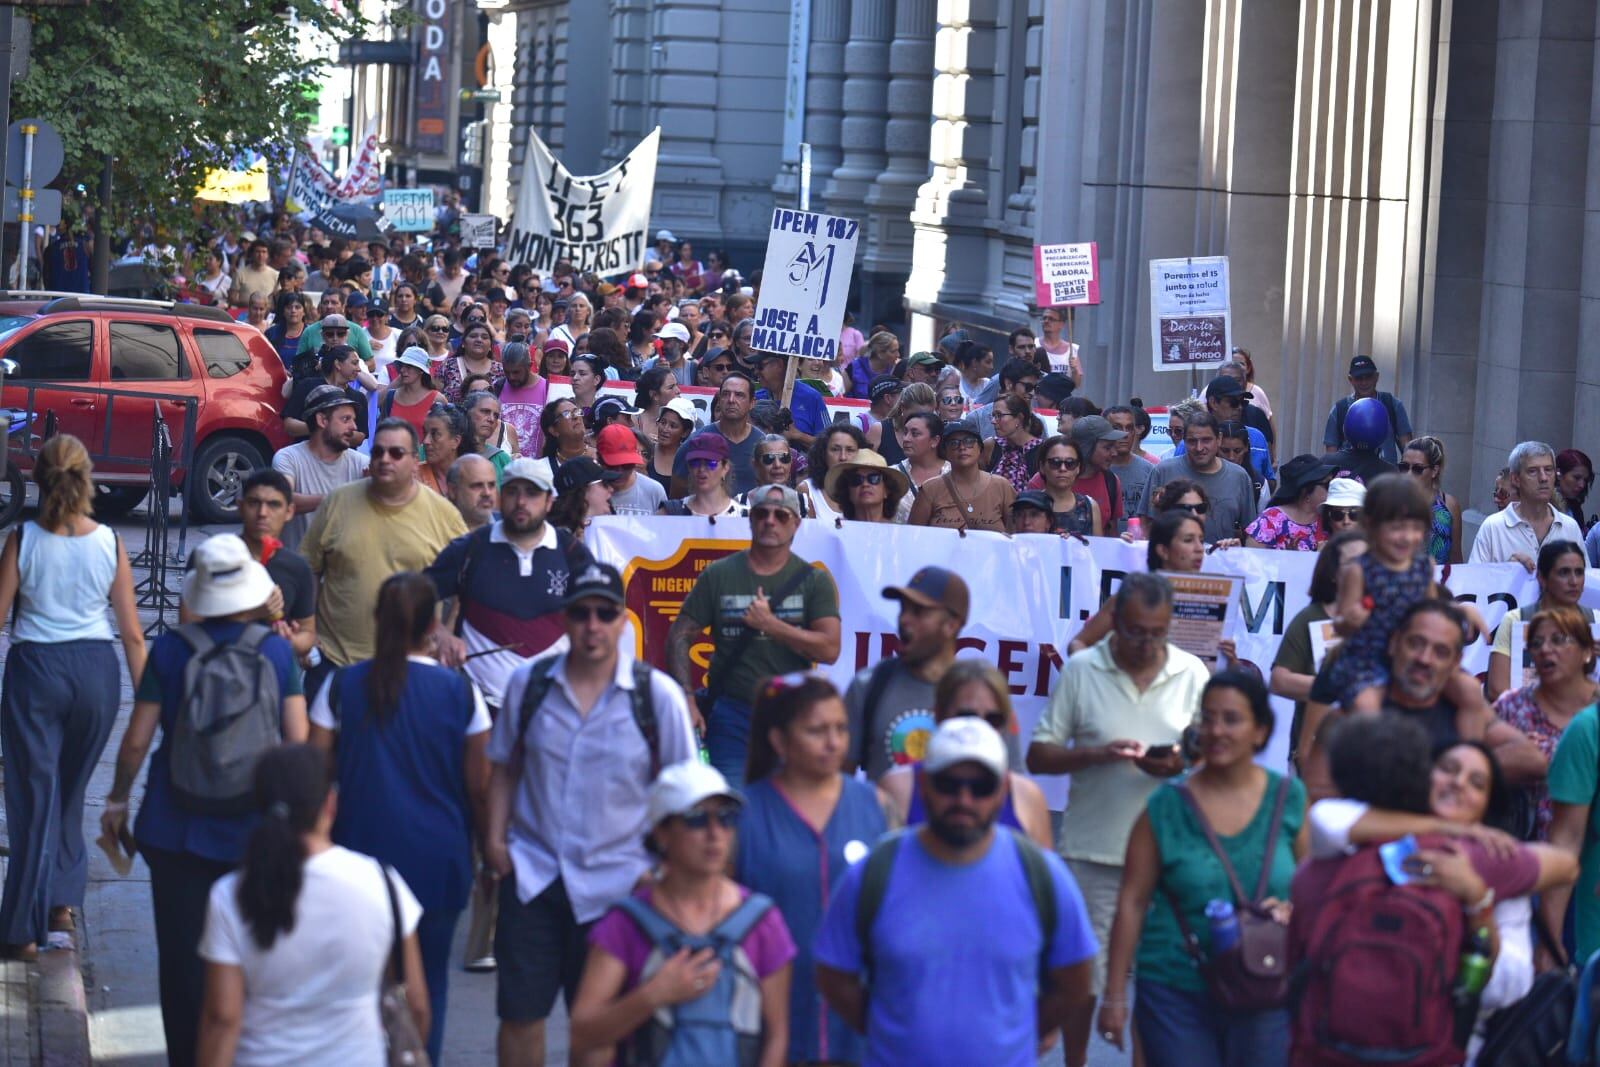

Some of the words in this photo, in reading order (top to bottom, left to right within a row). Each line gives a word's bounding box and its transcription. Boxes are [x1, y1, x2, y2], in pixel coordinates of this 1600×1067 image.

[394, 205, 426, 227] 101
[549, 194, 604, 243] 363
[773, 209, 820, 235] IPEM
[826, 217, 859, 240] 187
[1051, 268, 1090, 277] LABORAL
[1165, 283, 1187, 291] junto
[1196, 280, 1218, 288] salud
[755, 308, 799, 332] JOSE
[1170, 319, 1214, 333] Docentes
[751, 327, 836, 361] MALANCA
